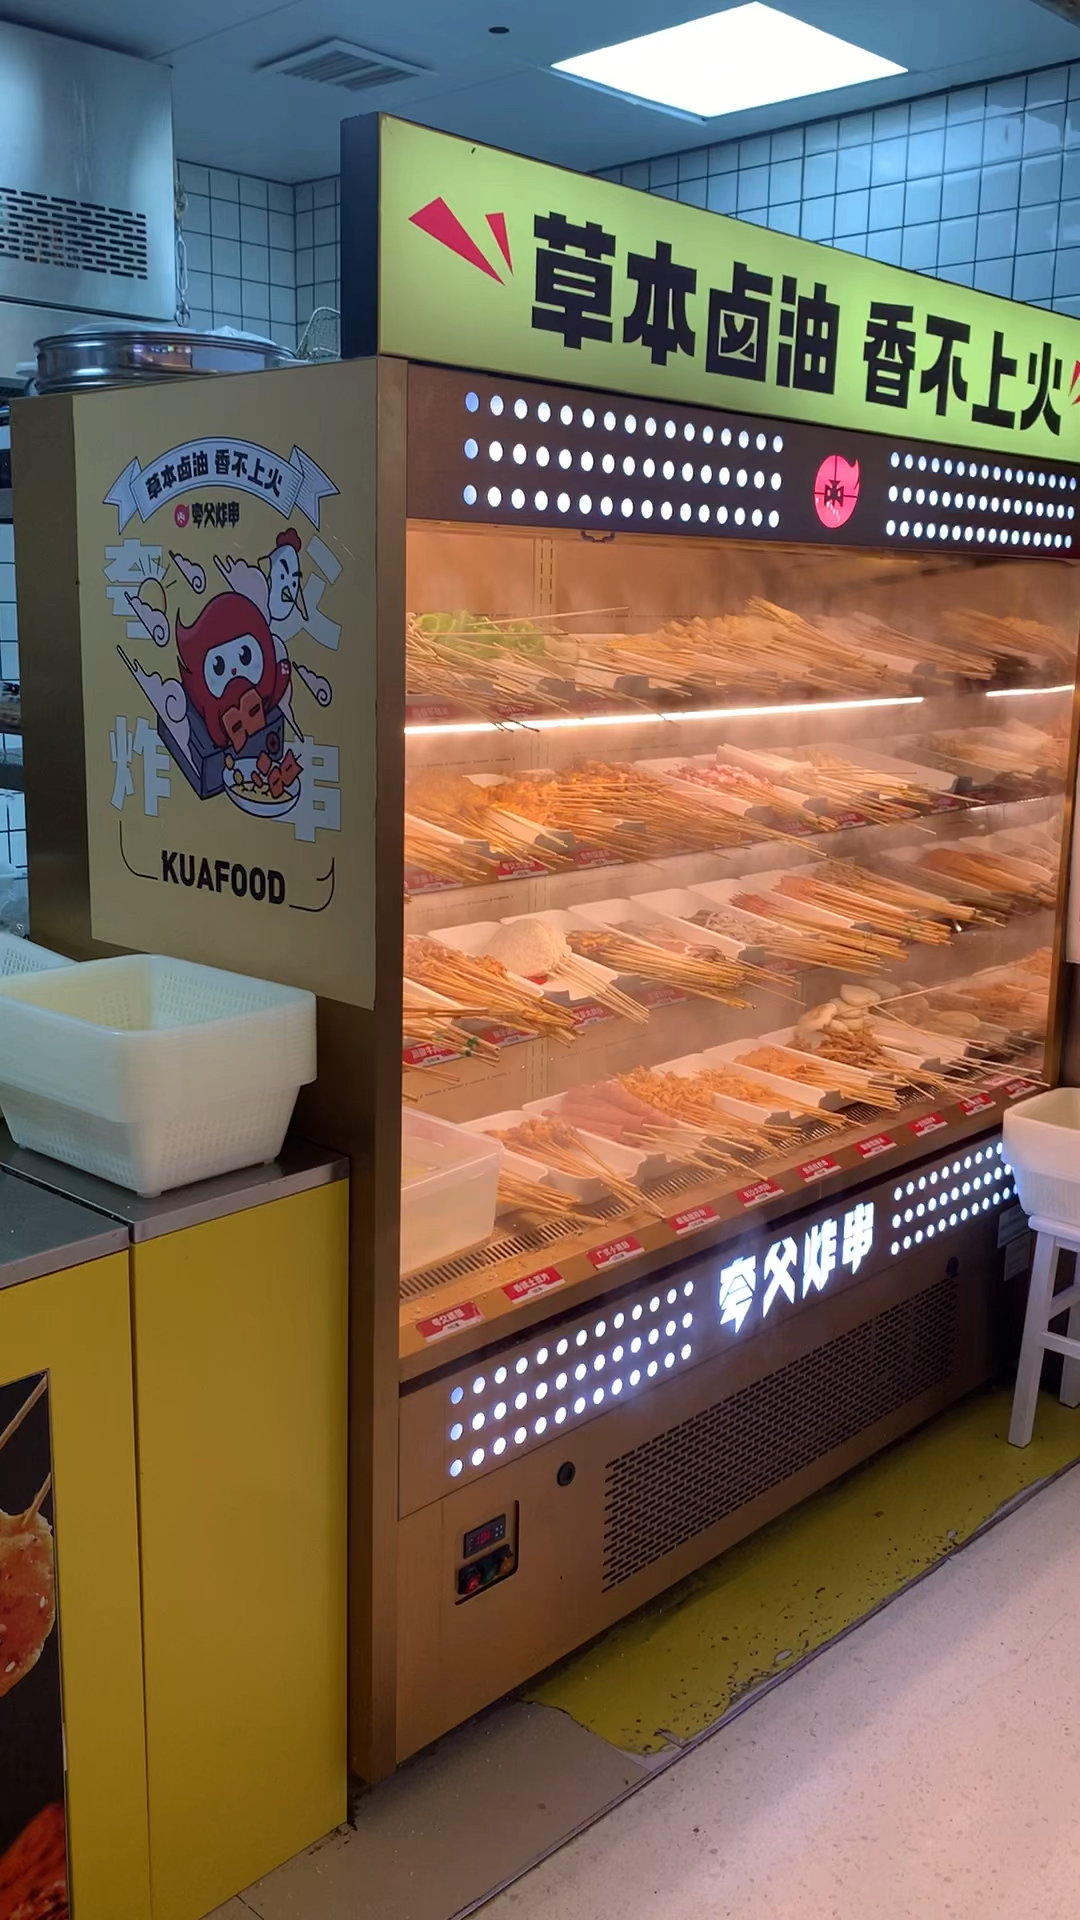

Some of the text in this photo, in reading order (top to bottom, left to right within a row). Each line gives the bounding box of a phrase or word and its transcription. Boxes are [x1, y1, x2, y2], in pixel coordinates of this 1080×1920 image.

[531, 211, 1064, 437] 草本卤油 香不上火
[145, 449, 283, 500] 草本卤油 香不上火
[191, 501, 240, 529] 夸父炸串
[161, 850, 286, 905] KUAFOOD
[719, 1202, 875, 1334] 夸父炸串
